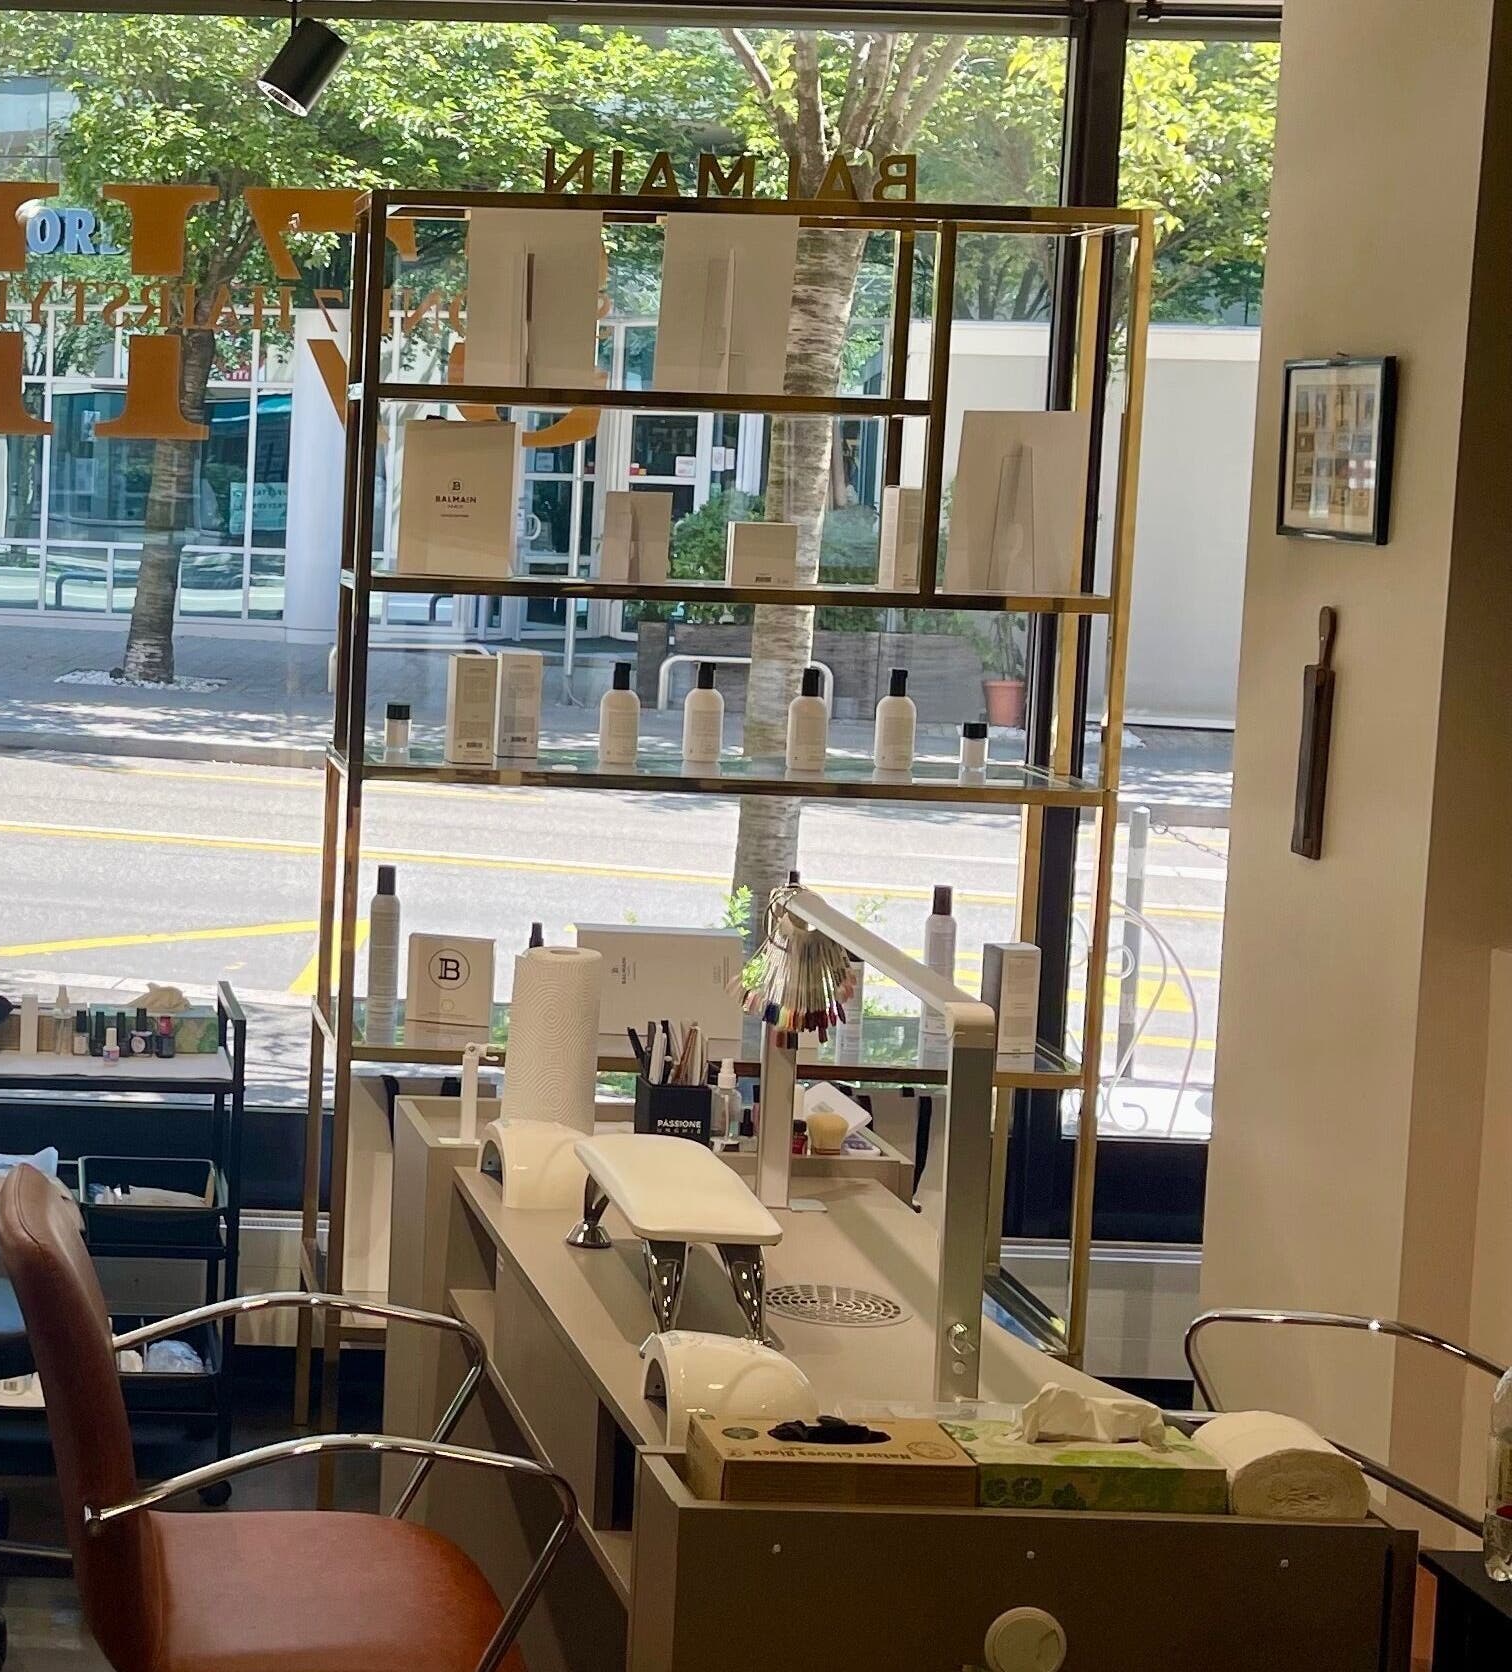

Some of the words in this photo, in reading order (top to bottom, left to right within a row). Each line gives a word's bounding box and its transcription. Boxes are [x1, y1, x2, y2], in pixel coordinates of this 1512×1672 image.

[435, 495, 477, 503] BALMAIN
[657, 1119, 701, 1128] PASSIONE
[753, 1449, 793, 1458] Black
[795, 1449, 853, 1459] Gloves
[856, 1451, 912, 1460] Nature
